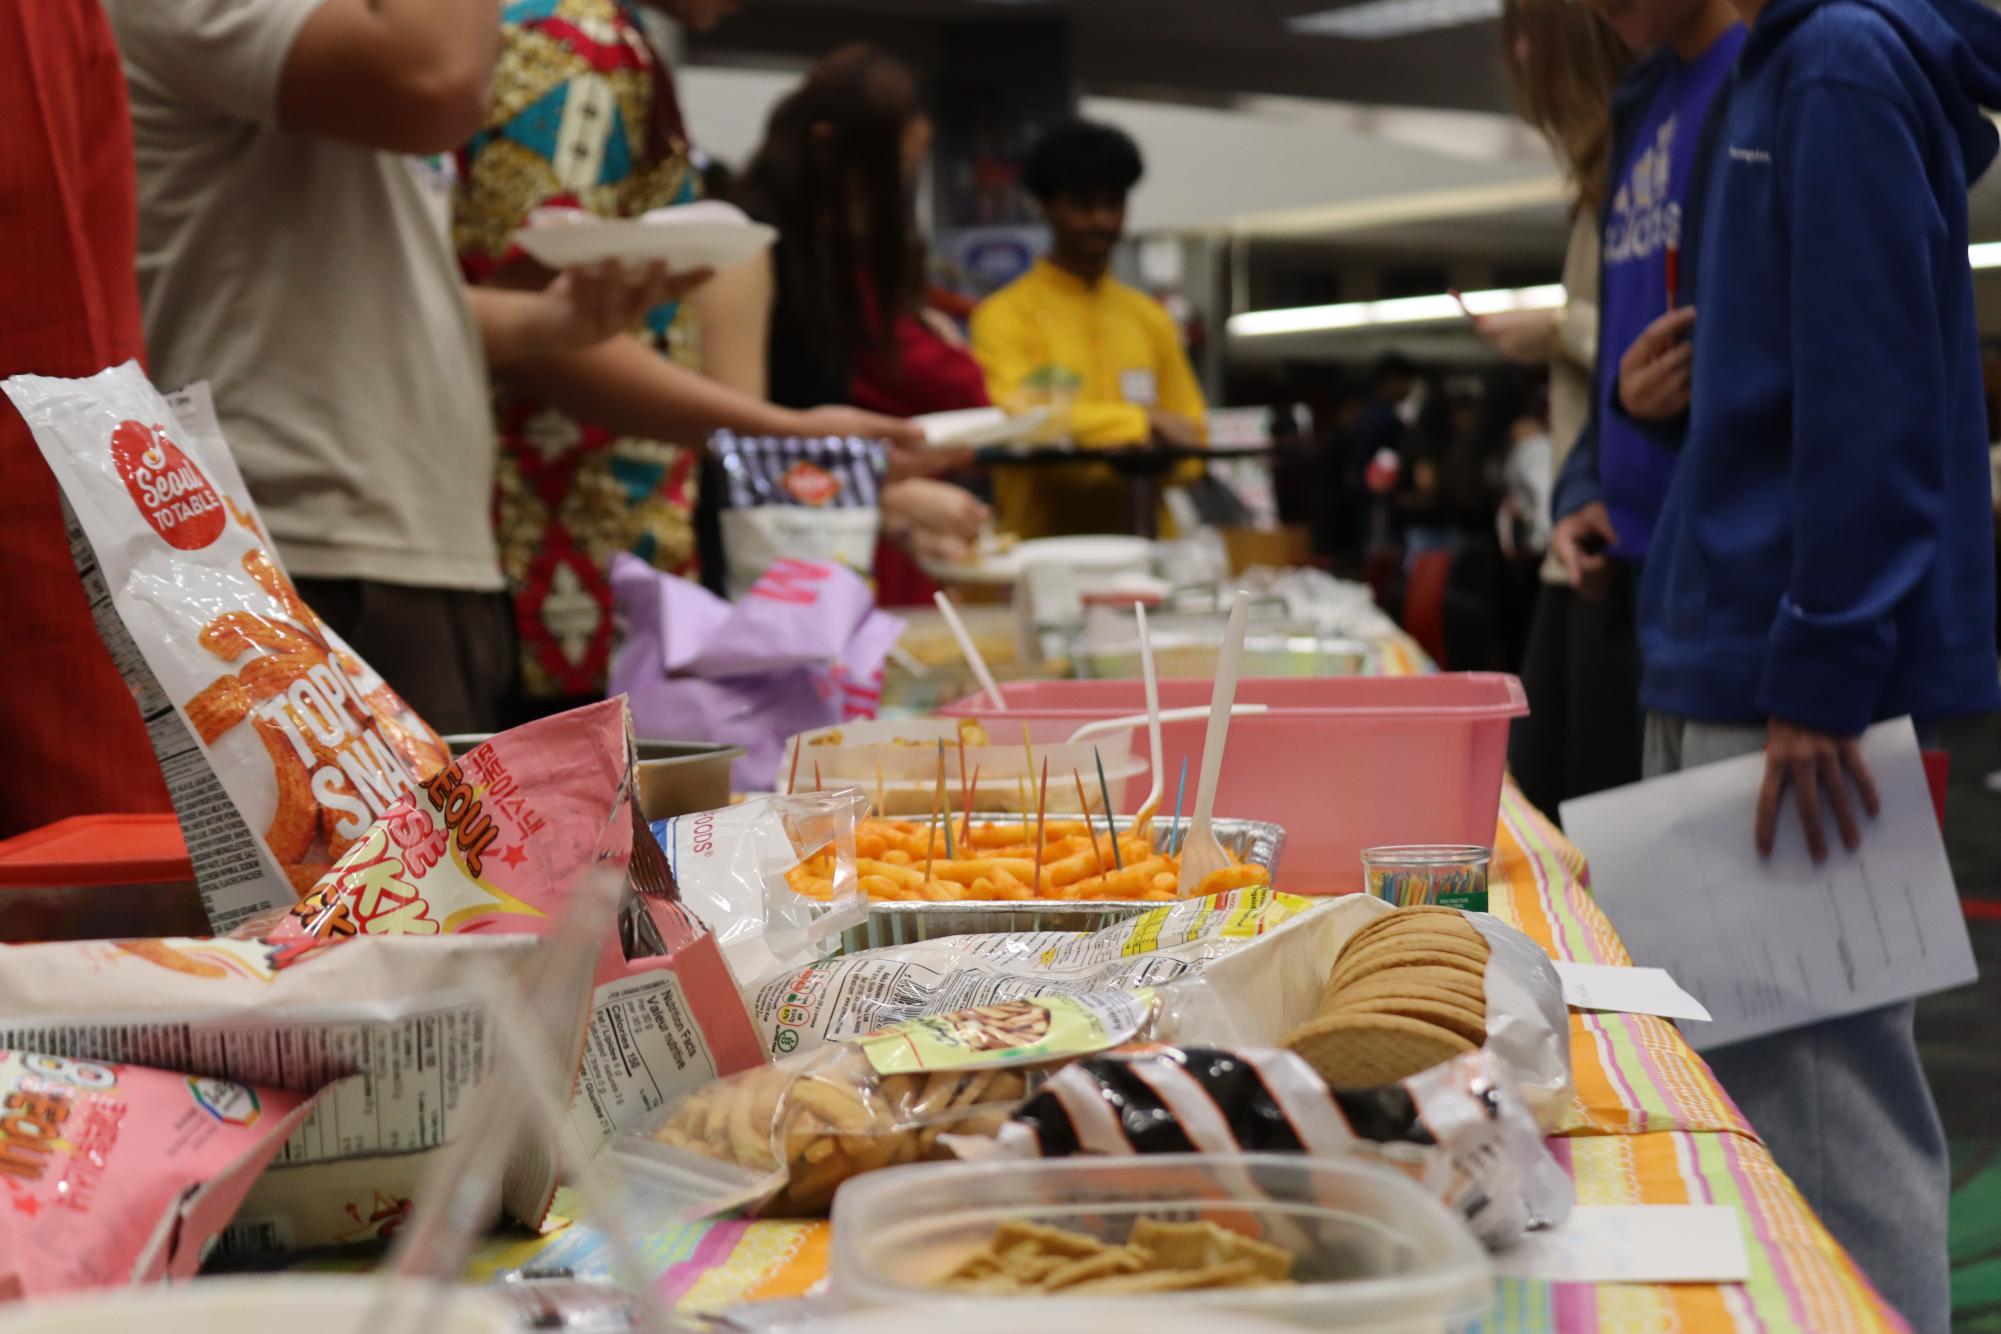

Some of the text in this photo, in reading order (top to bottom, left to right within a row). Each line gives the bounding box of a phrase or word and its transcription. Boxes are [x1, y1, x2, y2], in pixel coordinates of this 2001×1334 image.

[136, 459, 203, 508] Seoul
[152, 490, 220, 530] TO TABLE
[310, 728, 418, 840] SNA
[420, 761, 499, 879] EOUL
[693, 812, 713, 853] OODS
[600, 1030, 618, 1062] Lipides
[611, 1004, 630, 1049] Calories
[647, 994, 686, 1070] Valeur nutritive
[661, 989, 696, 1058] Nutrition Facts
